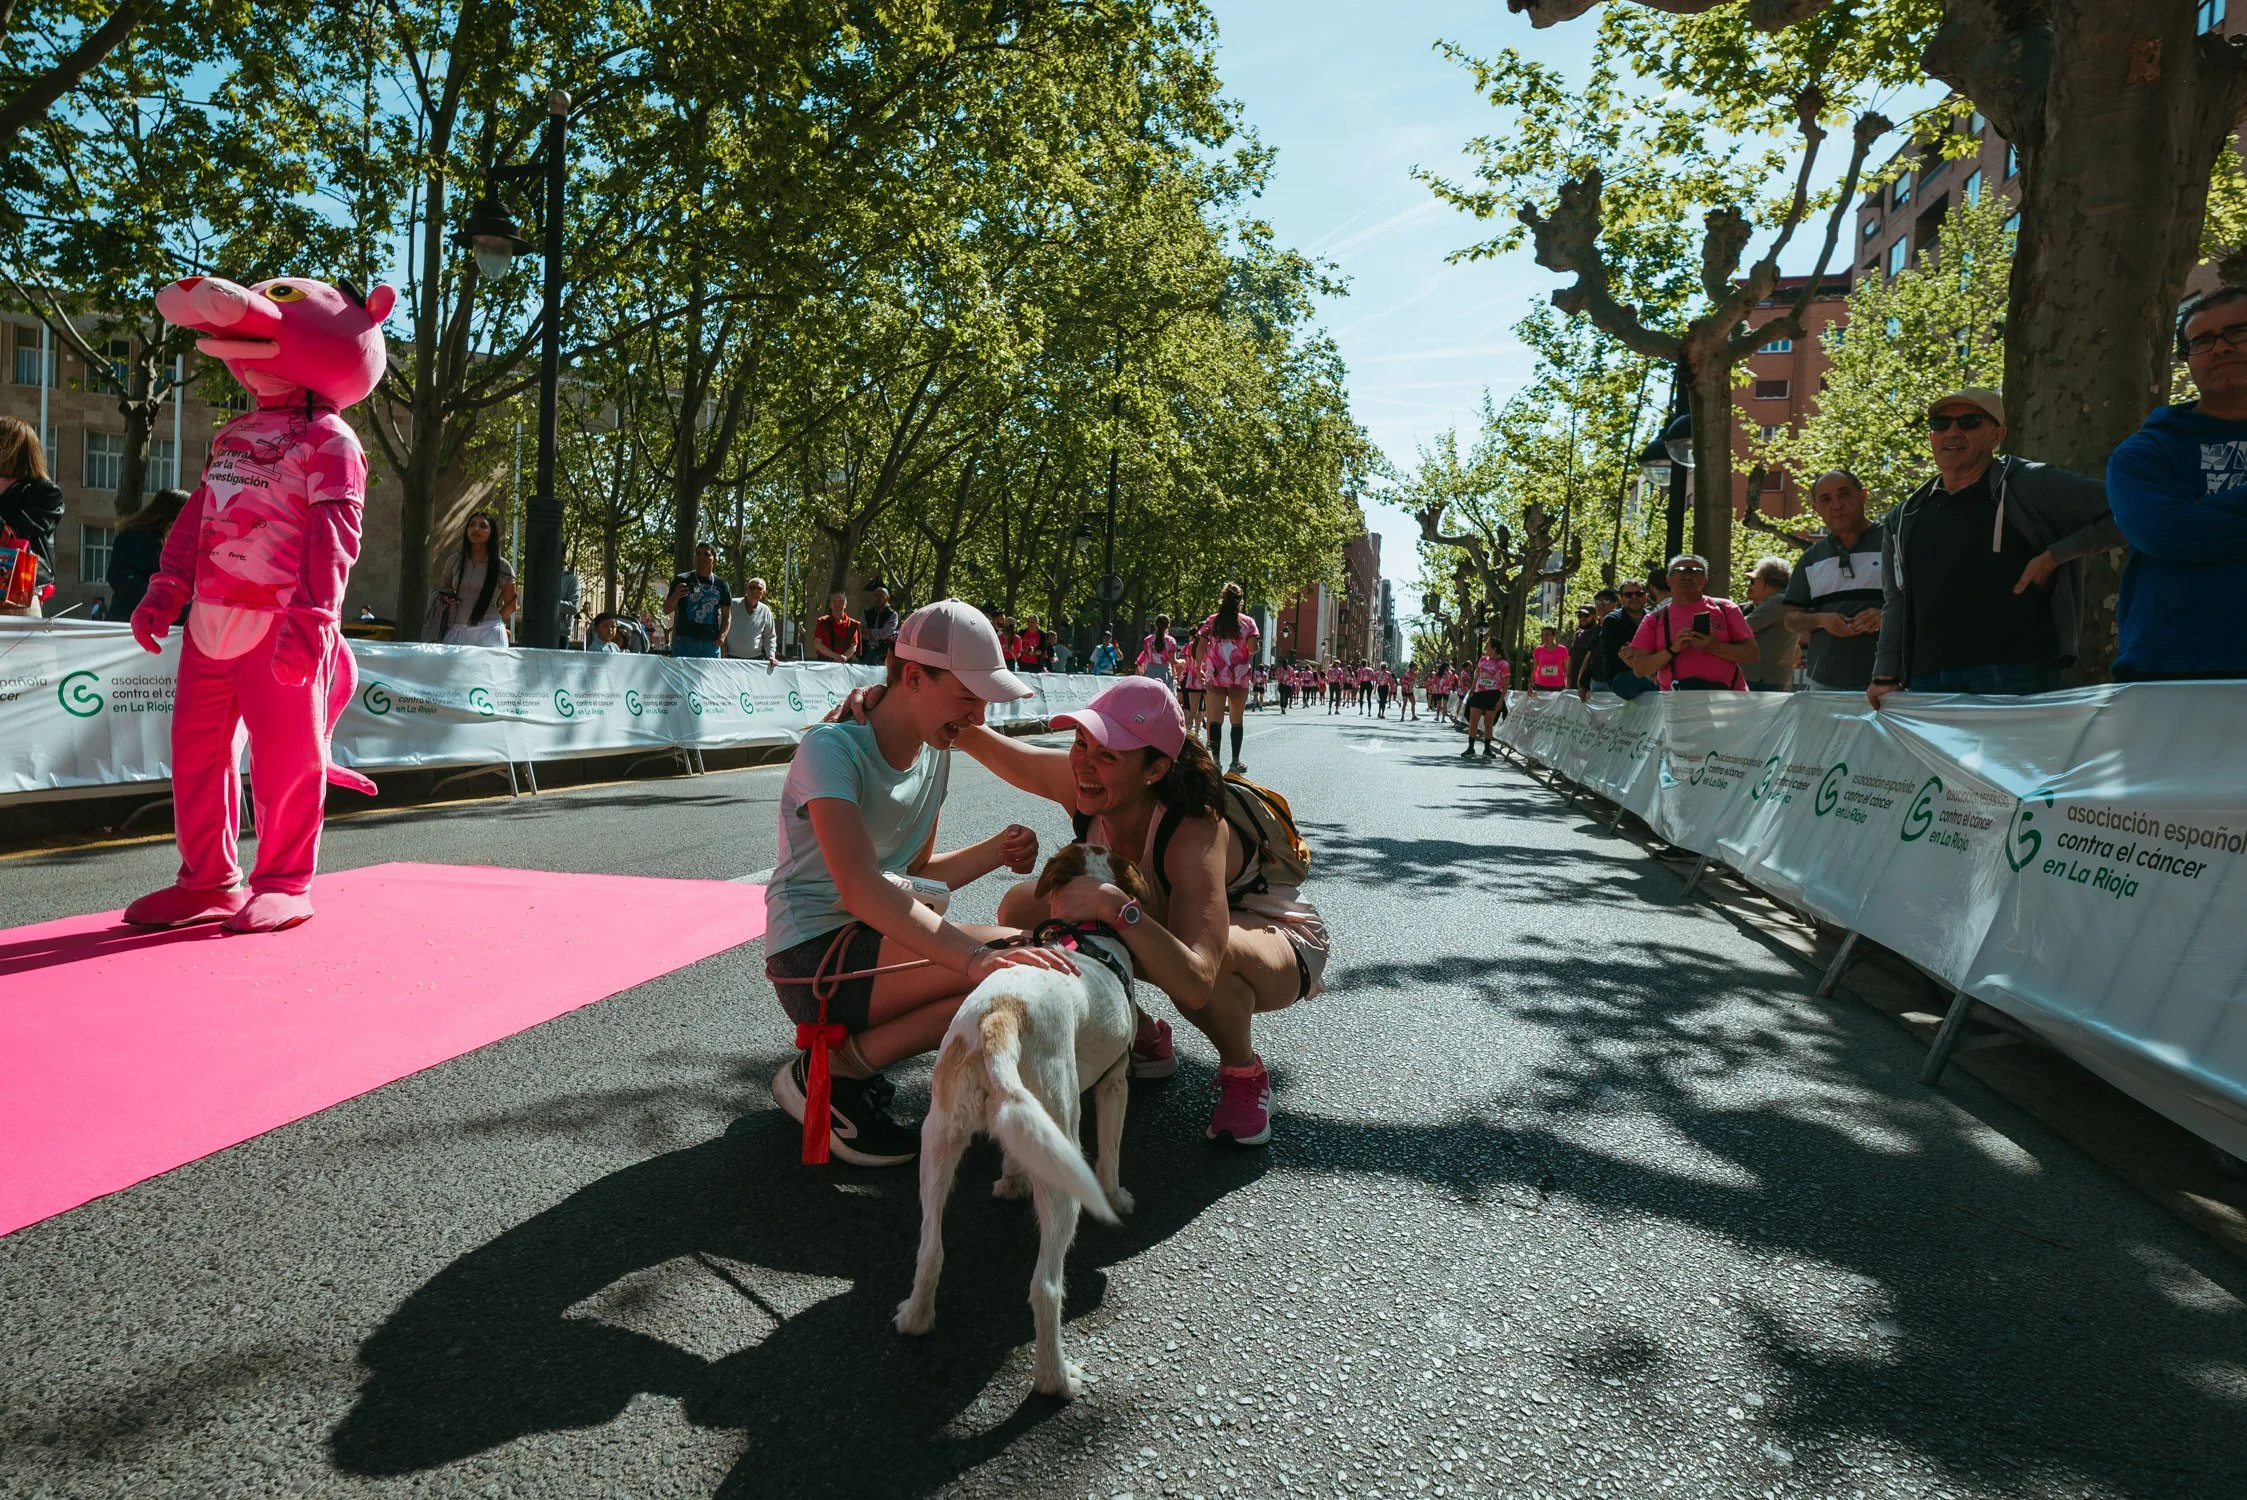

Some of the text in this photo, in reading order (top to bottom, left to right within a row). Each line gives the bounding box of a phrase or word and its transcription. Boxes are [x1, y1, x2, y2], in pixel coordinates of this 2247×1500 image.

[223, 459, 233, 470] la
[111, 675, 172, 686] asociación
[112, 688, 150, 699] contra
[152, 688, 162, 698] el
[113, 700, 173, 714] en La Rioja
[1884, 779, 1915, 794] española
[1939, 809, 1962, 825] contra
[1962, 811, 1971, 827] el
[2067, 805, 2159, 838] asociación
[1929, 829, 1969, 854] en La Rioja
[2057, 832, 2208, 880] contra el cáncer
[2043, 858, 2140, 900] en La Rioja
